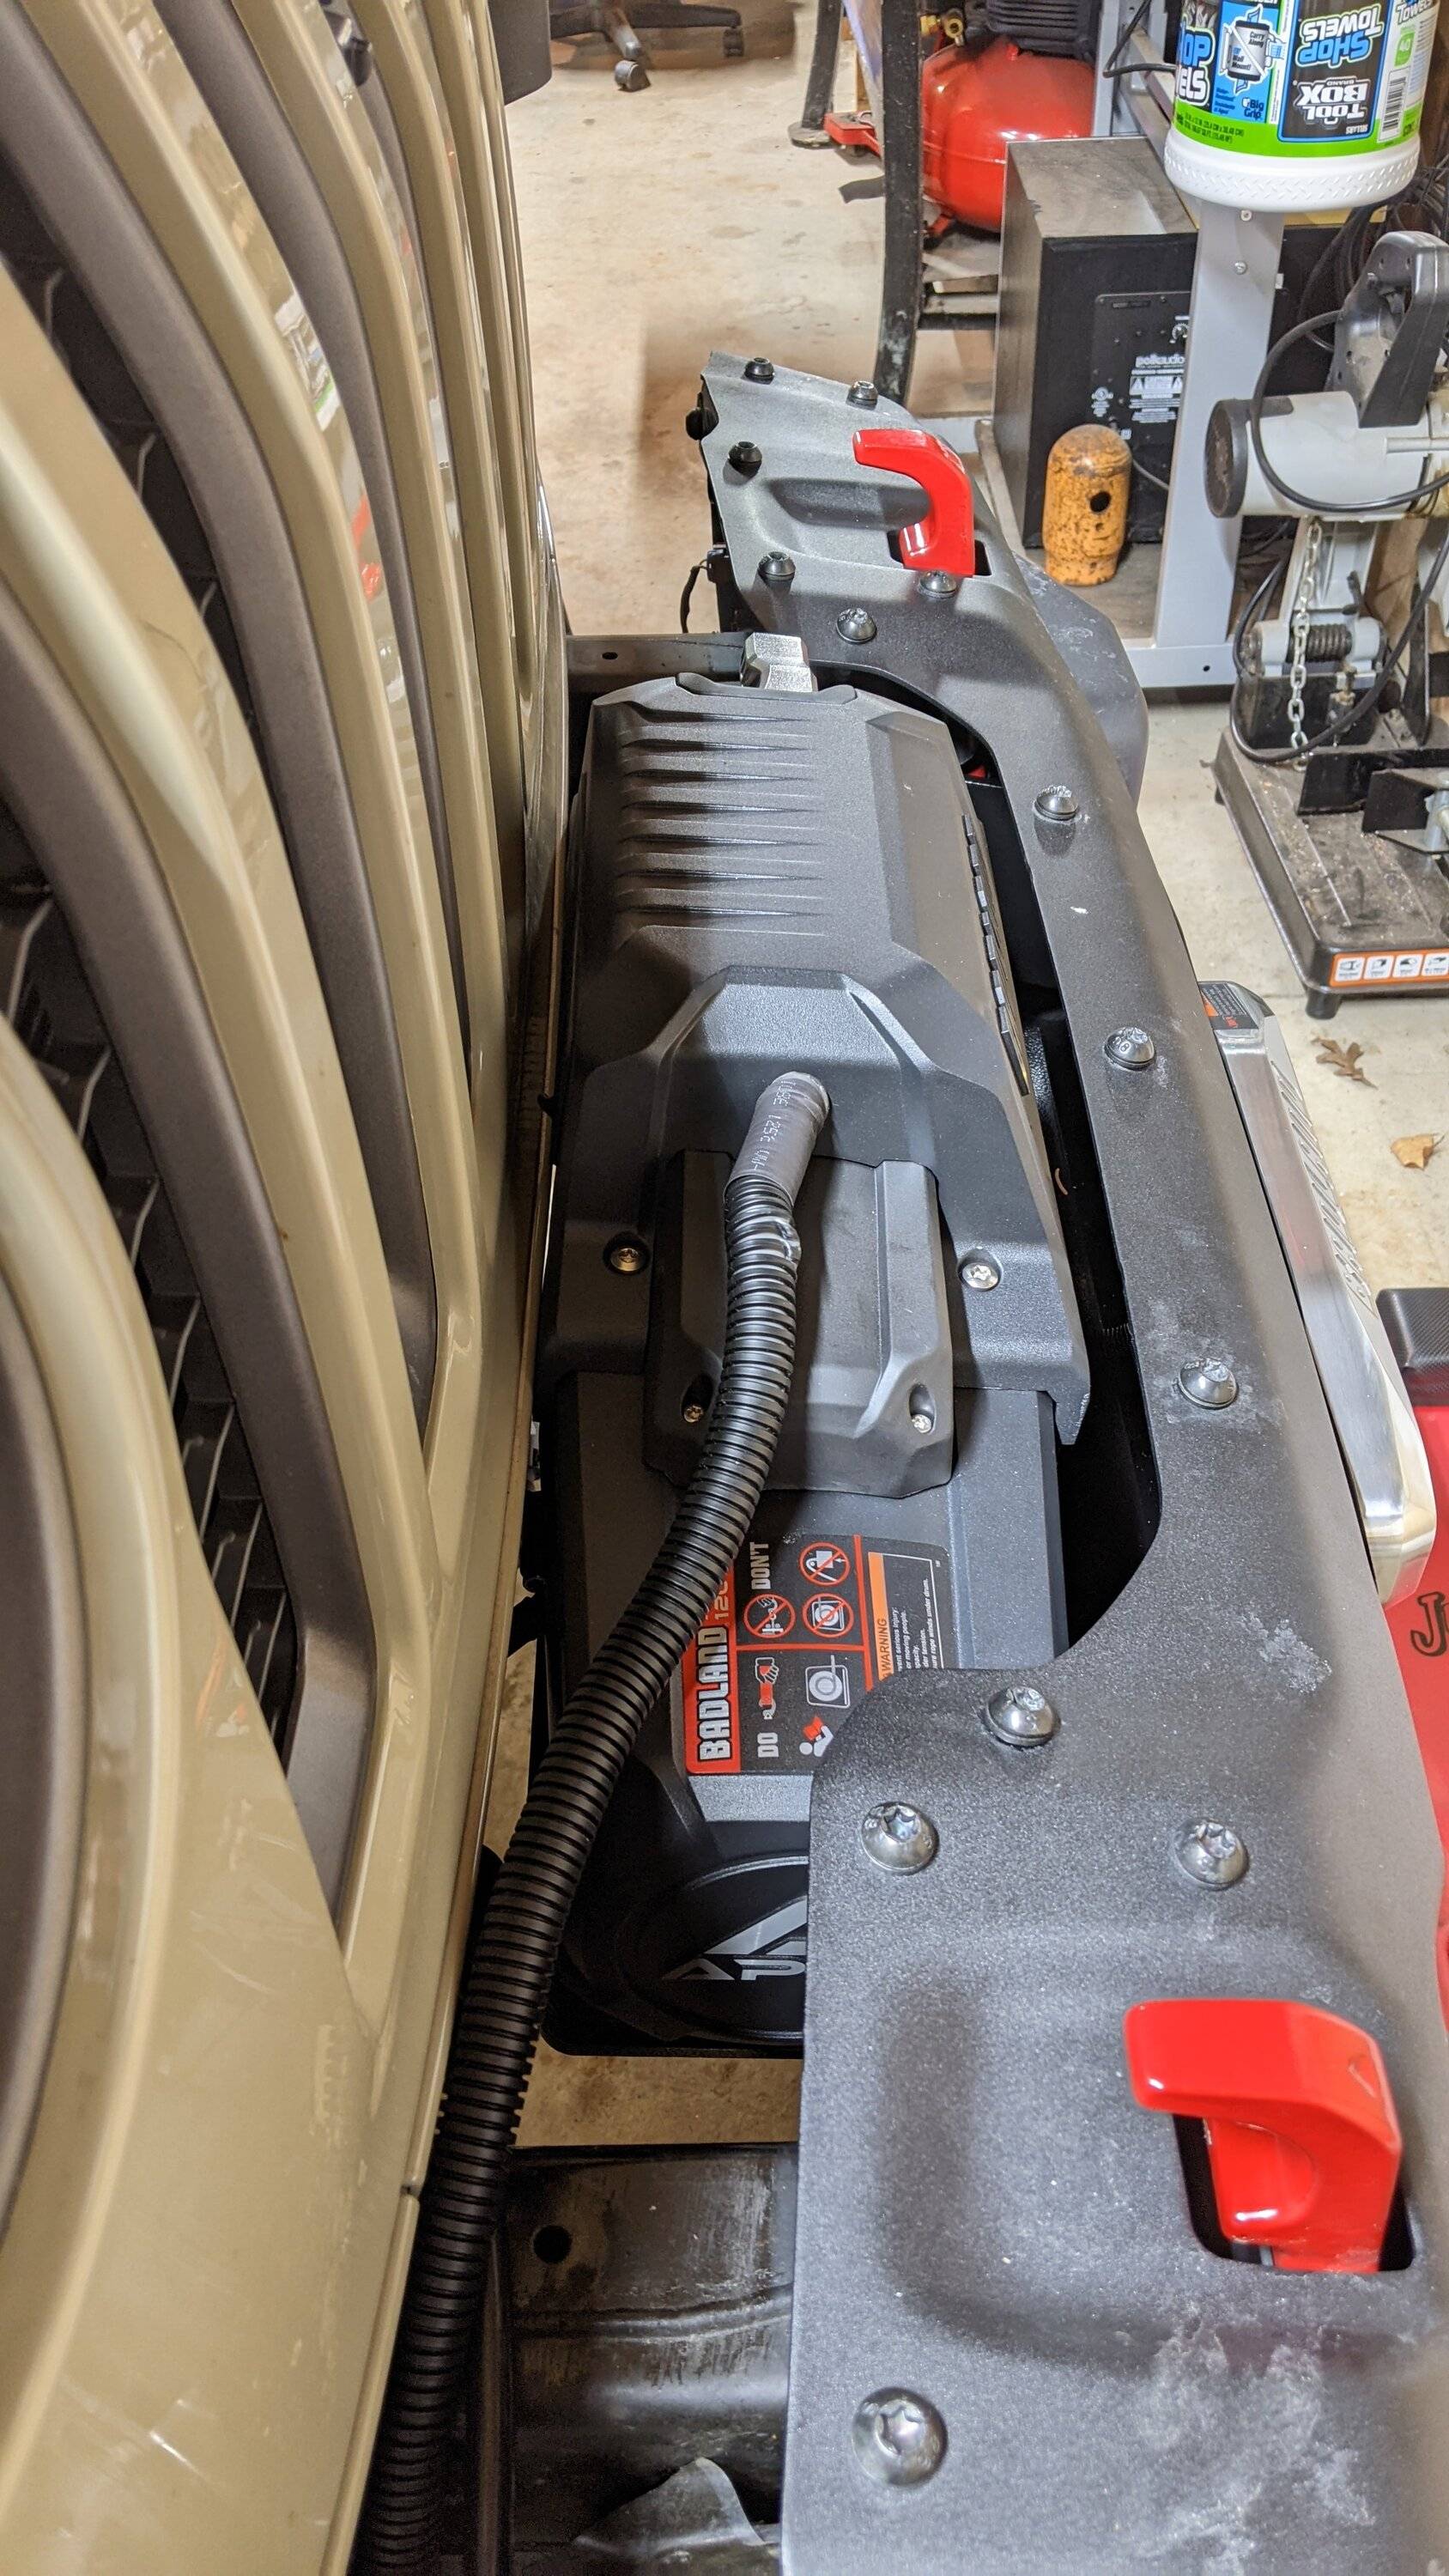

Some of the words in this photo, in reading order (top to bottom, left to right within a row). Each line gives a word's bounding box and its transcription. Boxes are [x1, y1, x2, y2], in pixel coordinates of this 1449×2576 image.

[1302, 7, 1381, 42] TOWELS
[1299, 31, 1369, 64] SHOP
[1250, 100, 1265, 112] Big
[1297, 83, 1368, 106] BOX
[1244, 108, 1262, 120] Grip
[1302, 103, 1366, 121] TOOL
[749, 1541, 772, 1590] DON'T
[900, 1610, 909, 1635] people.
[926, 1618, 935, 1638] winds
[877, 1618, 890, 1673] WARNING
[893, 1629, 901, 1655] serious
[902, 1635, 911, 1661] moving
[919, 1628, 928, 1656] tension.
[928, 1638, 937, 1655] rope
[905, 1661, 912, 1669] or
[698, 1626, 731, 1761] BADLAND
[757, 1732, 779, 1758] DO
